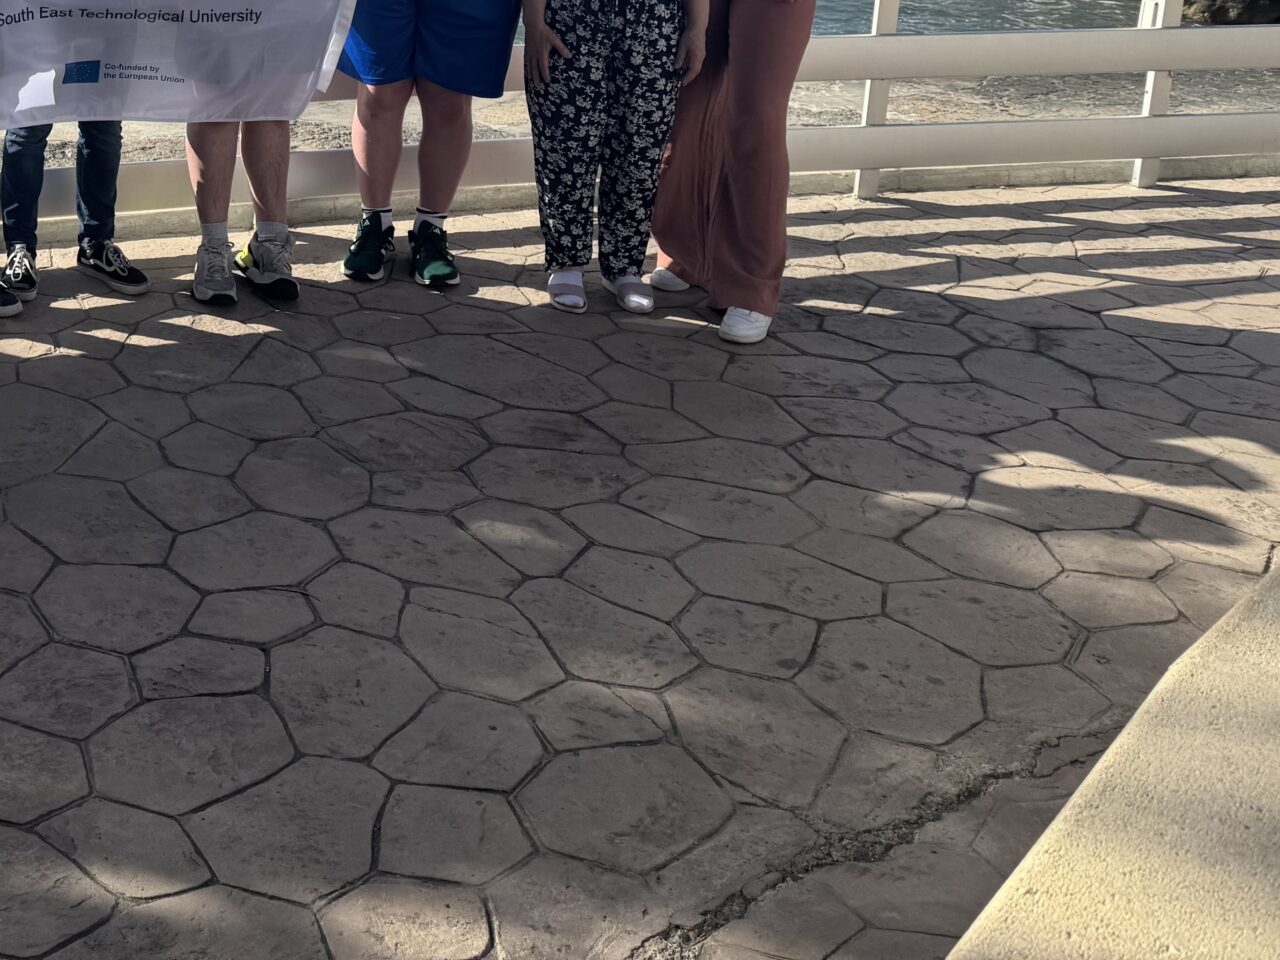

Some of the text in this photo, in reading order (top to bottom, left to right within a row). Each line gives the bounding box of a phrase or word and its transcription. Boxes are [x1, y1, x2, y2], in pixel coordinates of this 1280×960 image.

[39, 6, 74, 19] East
[78, 8, 185, 23] Technological
[190, 7, 263, 25] University
[104, 63, 160, 74] Co-funded by
[118, 72, 159, 81] European
[160, 75, 185, 84] Union
